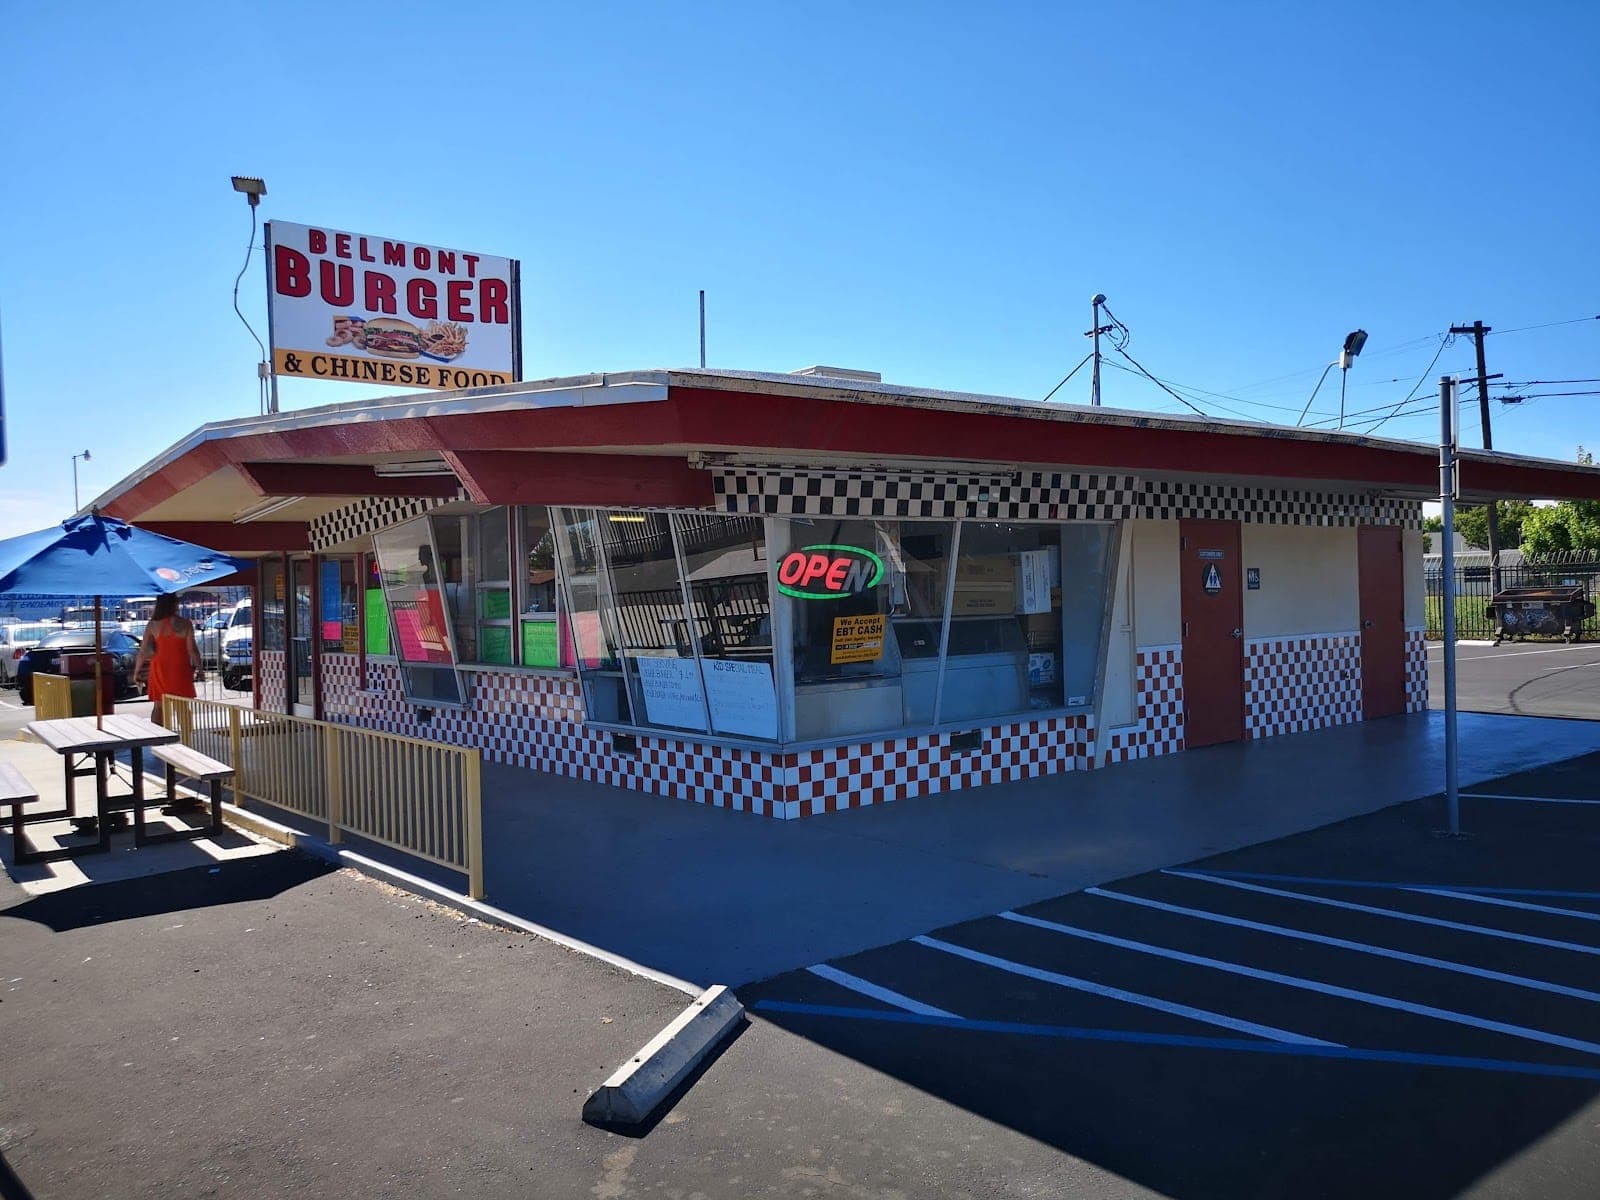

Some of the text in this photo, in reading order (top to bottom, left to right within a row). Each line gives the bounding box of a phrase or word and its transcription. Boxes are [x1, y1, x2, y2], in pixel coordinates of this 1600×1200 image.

[309, 229, 479, 277] BELMONT
[275, 244, 508, 324] BURGER
[284, 353, 505, 389] & CHINESE FOOD
[779, 552, 872, 592] OPEN
[836, 624, 883, 636] EBT CASH
[840, 617, 880, 626] We Accept
